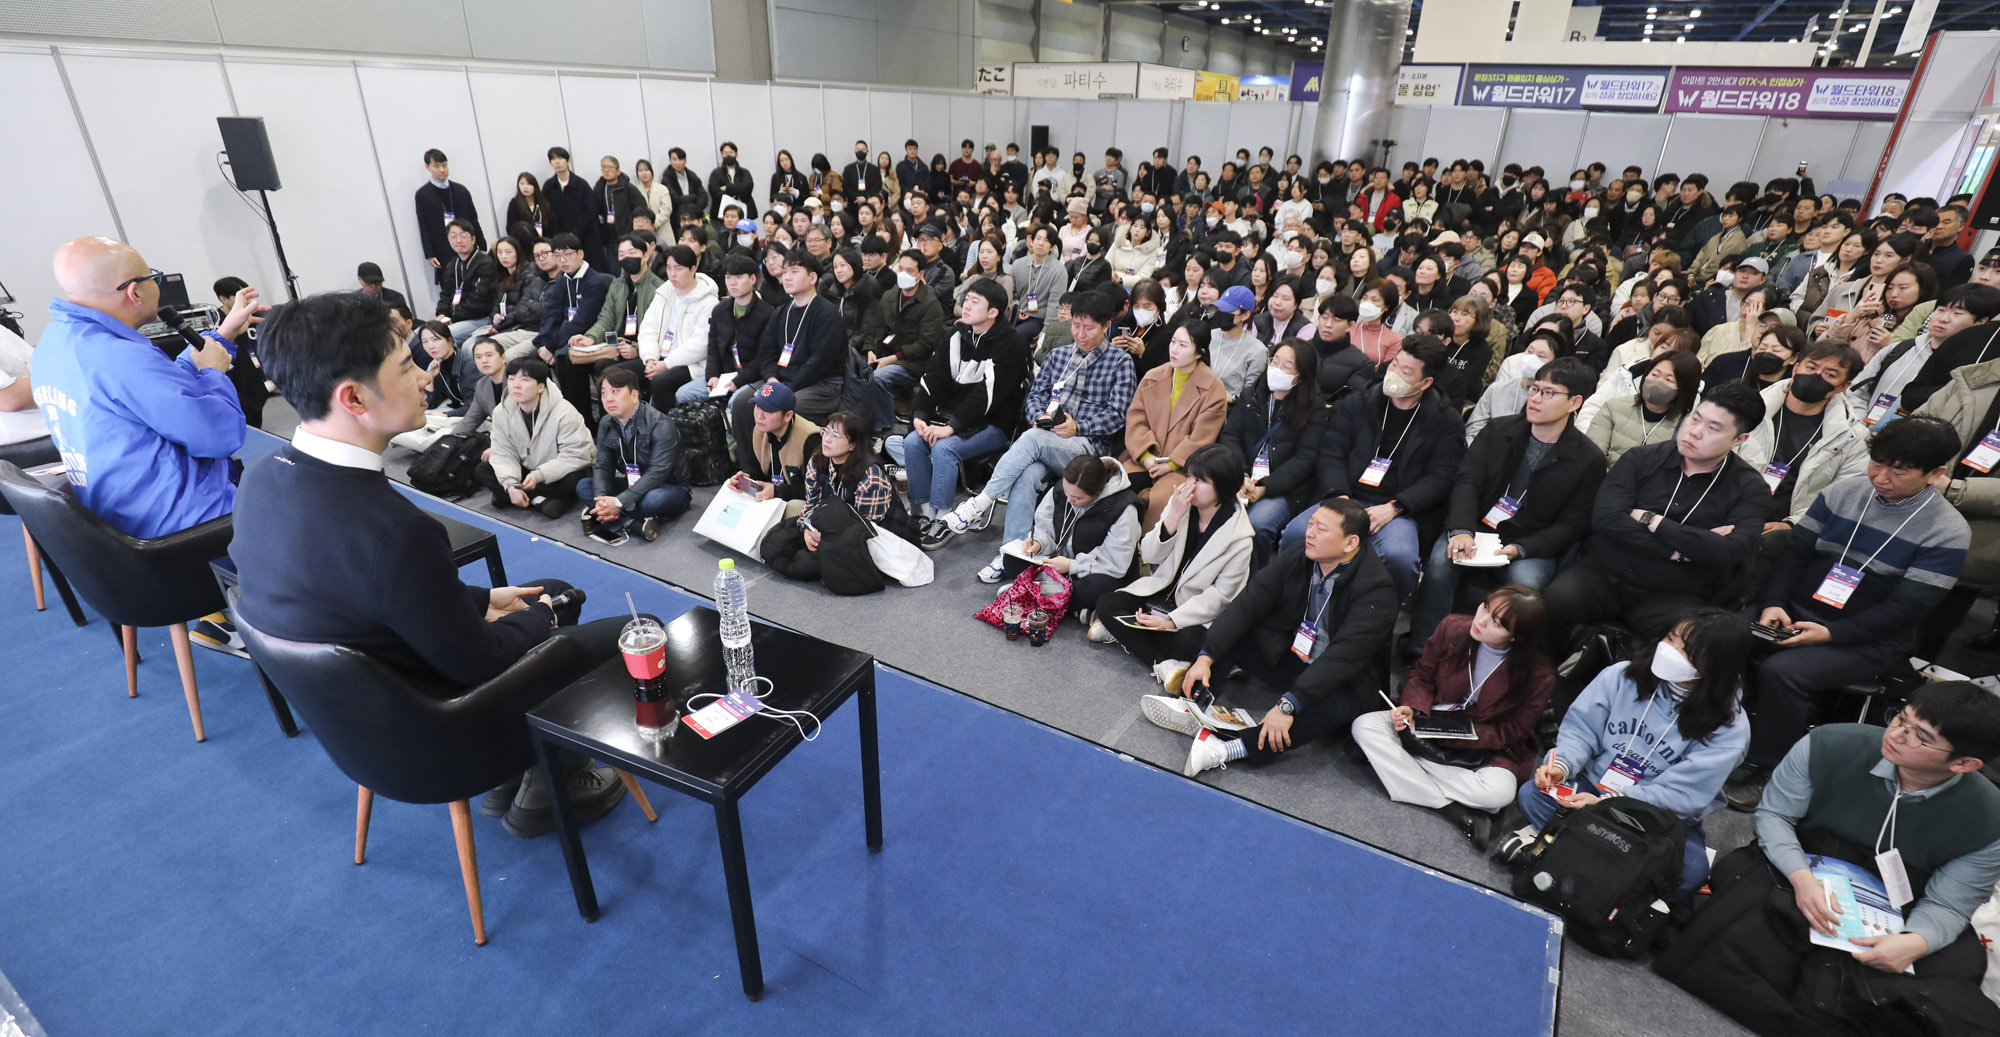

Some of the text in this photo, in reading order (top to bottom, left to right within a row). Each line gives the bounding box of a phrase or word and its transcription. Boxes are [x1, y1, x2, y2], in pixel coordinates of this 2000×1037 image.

[978, 67, 1005, 82] たこ
[1064, 70, 1107, 89] 파티수
[1681, 76, 1706, 86] 아파트
[1738, 77, 1767, 86] GTX-A
[1491, 85, 1576, 104] 월드타워17
[1617, 91, 1658, 101] 창업하세요
[1700, 90, 1801, 110] 월드타워18
[1851, 97, 1900, 107] 창업하세요
